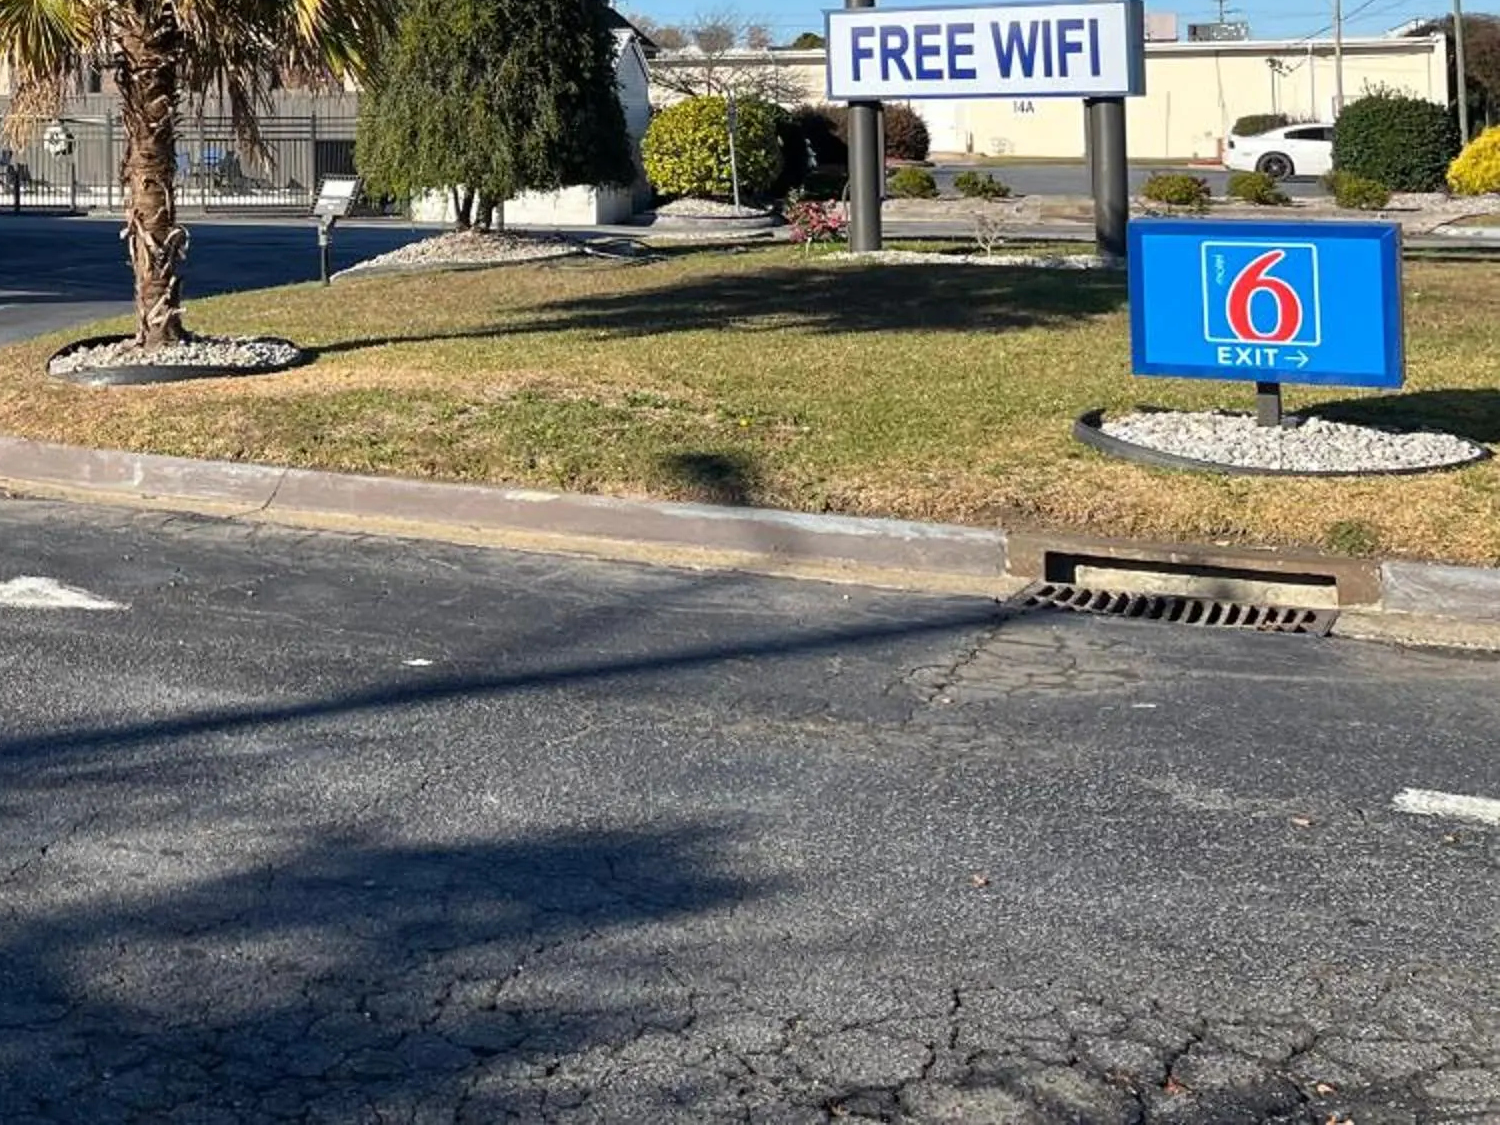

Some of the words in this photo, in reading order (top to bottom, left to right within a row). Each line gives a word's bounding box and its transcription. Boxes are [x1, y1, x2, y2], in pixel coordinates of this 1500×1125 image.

[850, 22, 977, 82] FREE
[990, 18, 1101, 79] WIFI
[1013, 100, 1035, 114] 14A
[1225, 249, 1303, 344] 6
[1217, 346, 1279, 367] EXIT
